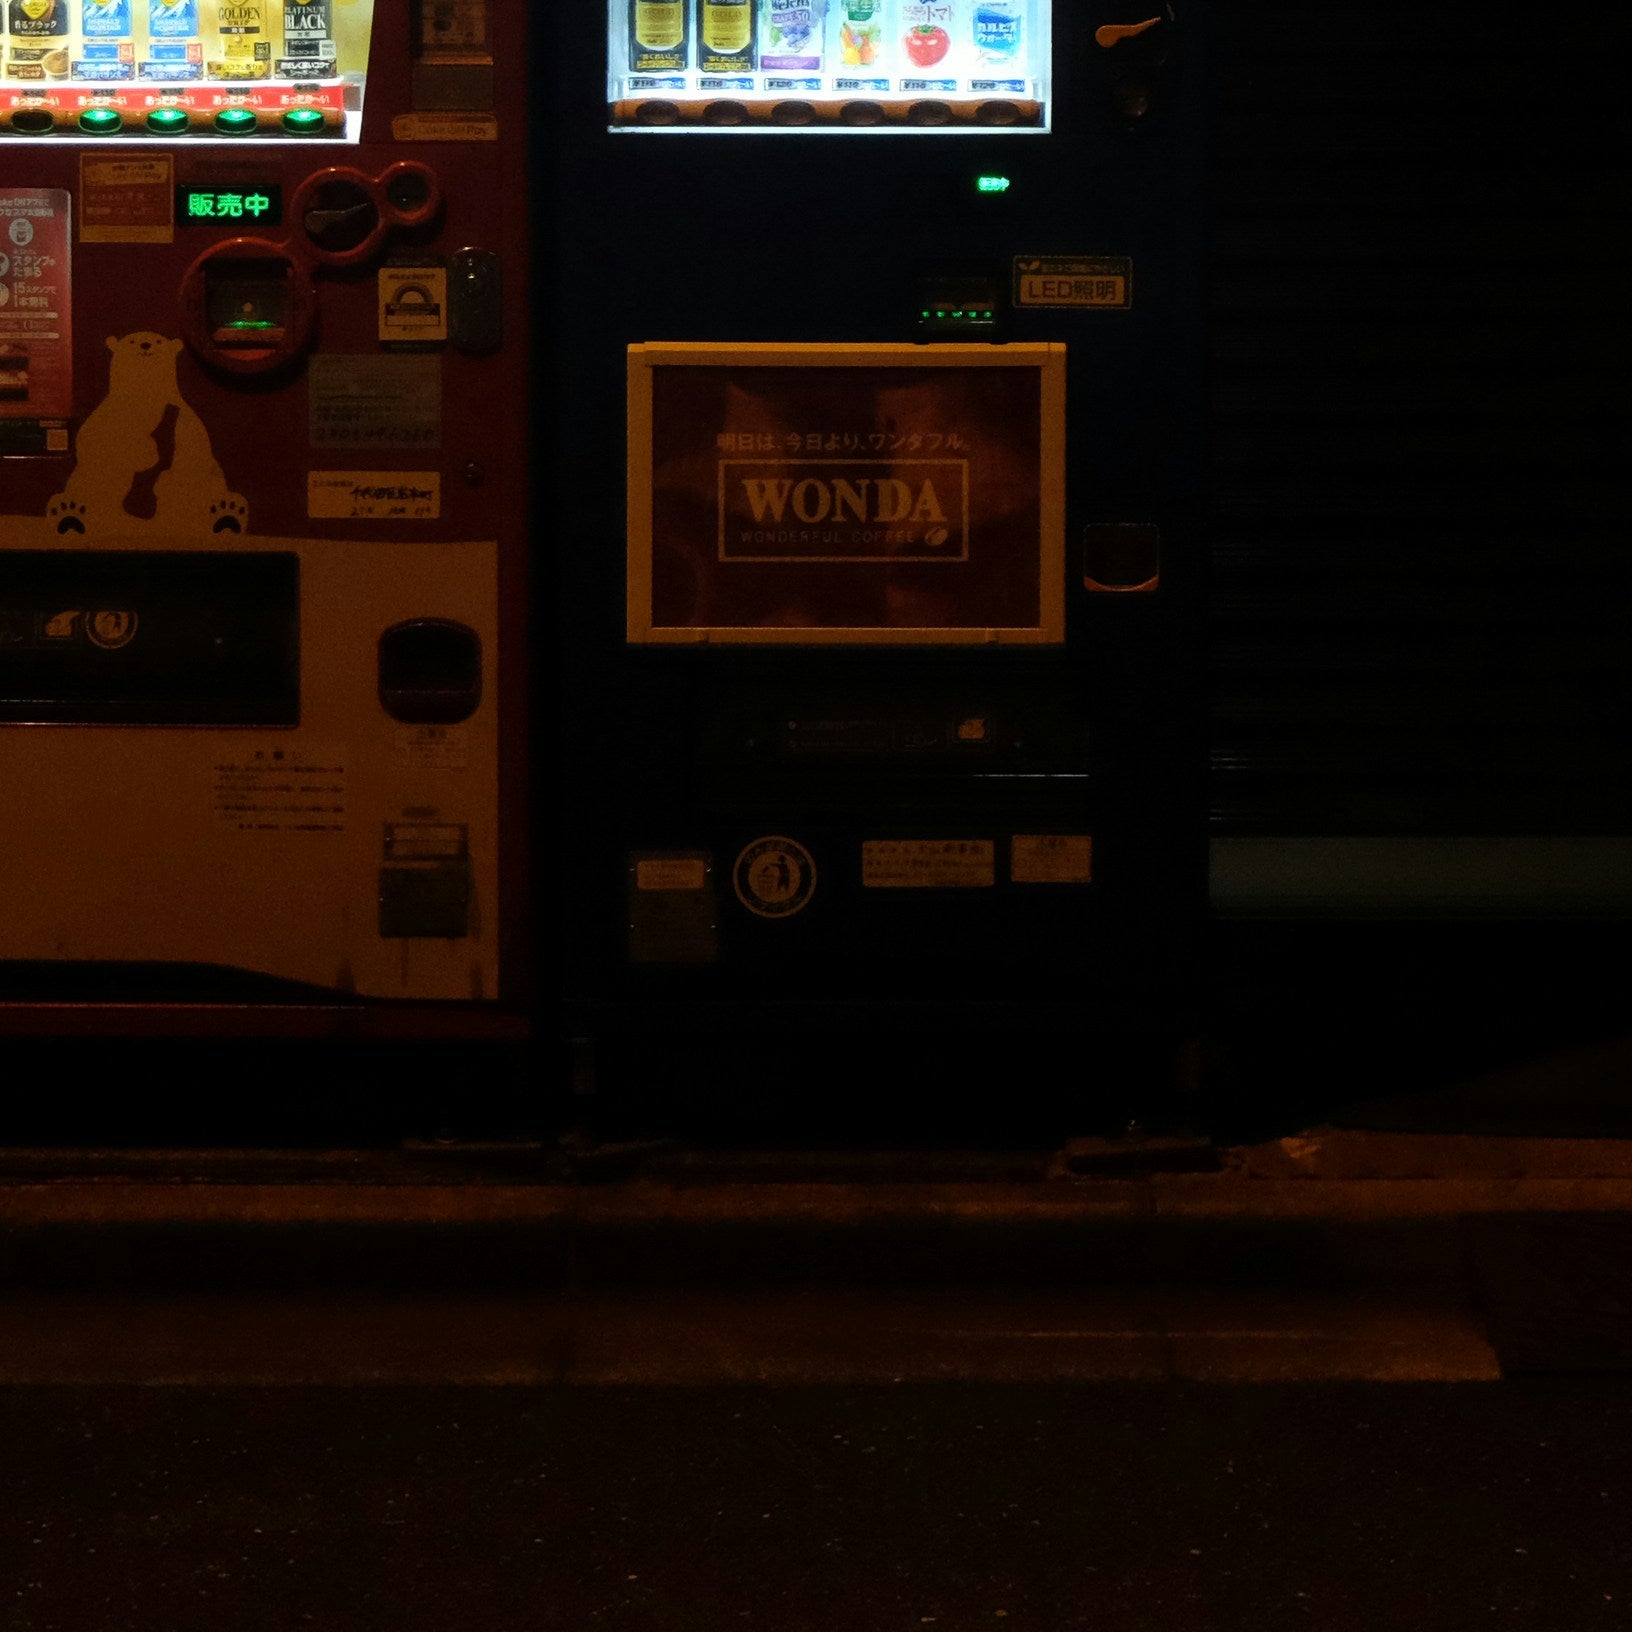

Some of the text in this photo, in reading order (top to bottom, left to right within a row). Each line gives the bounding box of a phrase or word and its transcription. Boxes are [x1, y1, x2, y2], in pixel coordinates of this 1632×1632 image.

[219, 7, 260, 20] GOLDEN
[285, 14, 325, 29] BLACK
[188, 192, 270, 217] 販売中
[1029, 280, 1115, 300] LED照明
[741, 478, 948, 523] WONDA
[739, 529, 915, 543] WONDERFUL COFFEE
